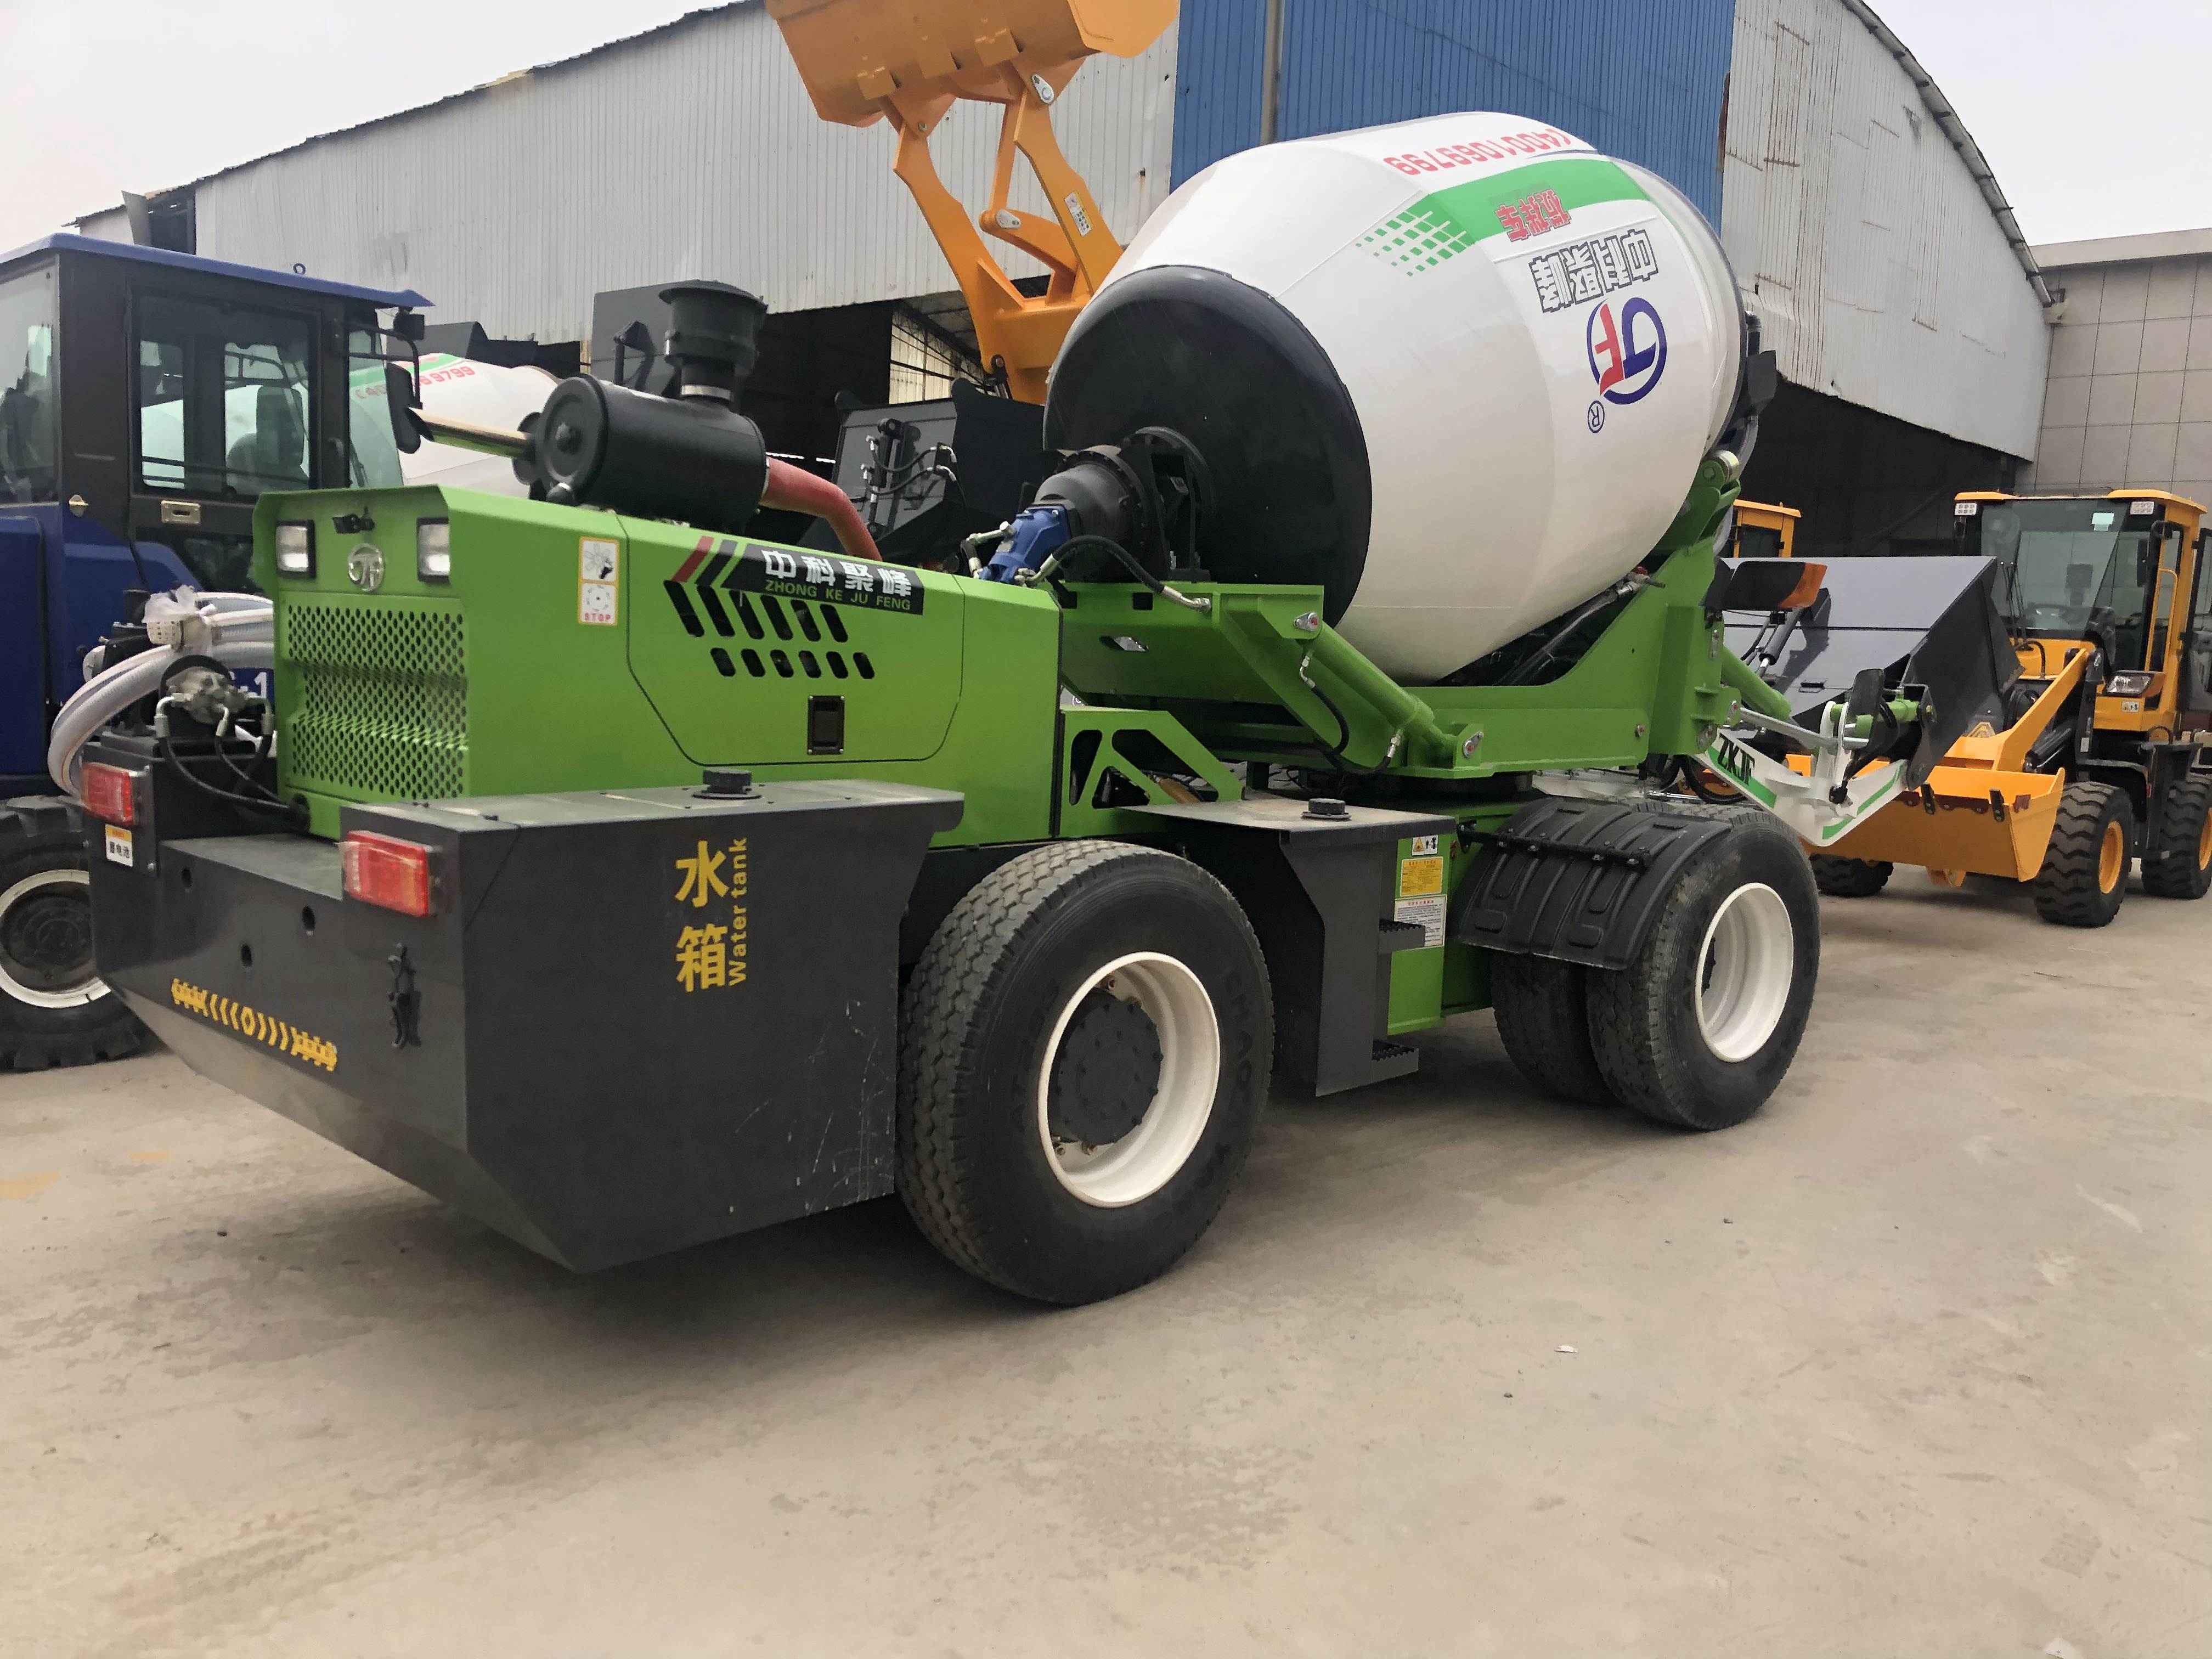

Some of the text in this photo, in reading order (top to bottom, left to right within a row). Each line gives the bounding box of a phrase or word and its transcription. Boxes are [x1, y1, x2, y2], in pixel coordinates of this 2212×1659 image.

[1494, 189, 1572, 242] 搅拌车
[1529, 229, 1658, 313] 中科聚峰
[761, 549, 912, 597] 中科聚峰
[765, 579, 911, 610] ZHONG KE JU FENG
[585, 612, 611, 622] STOP
[675, 840, 730, 992] 水箱
[728, 837, 747, 986] Water tank
